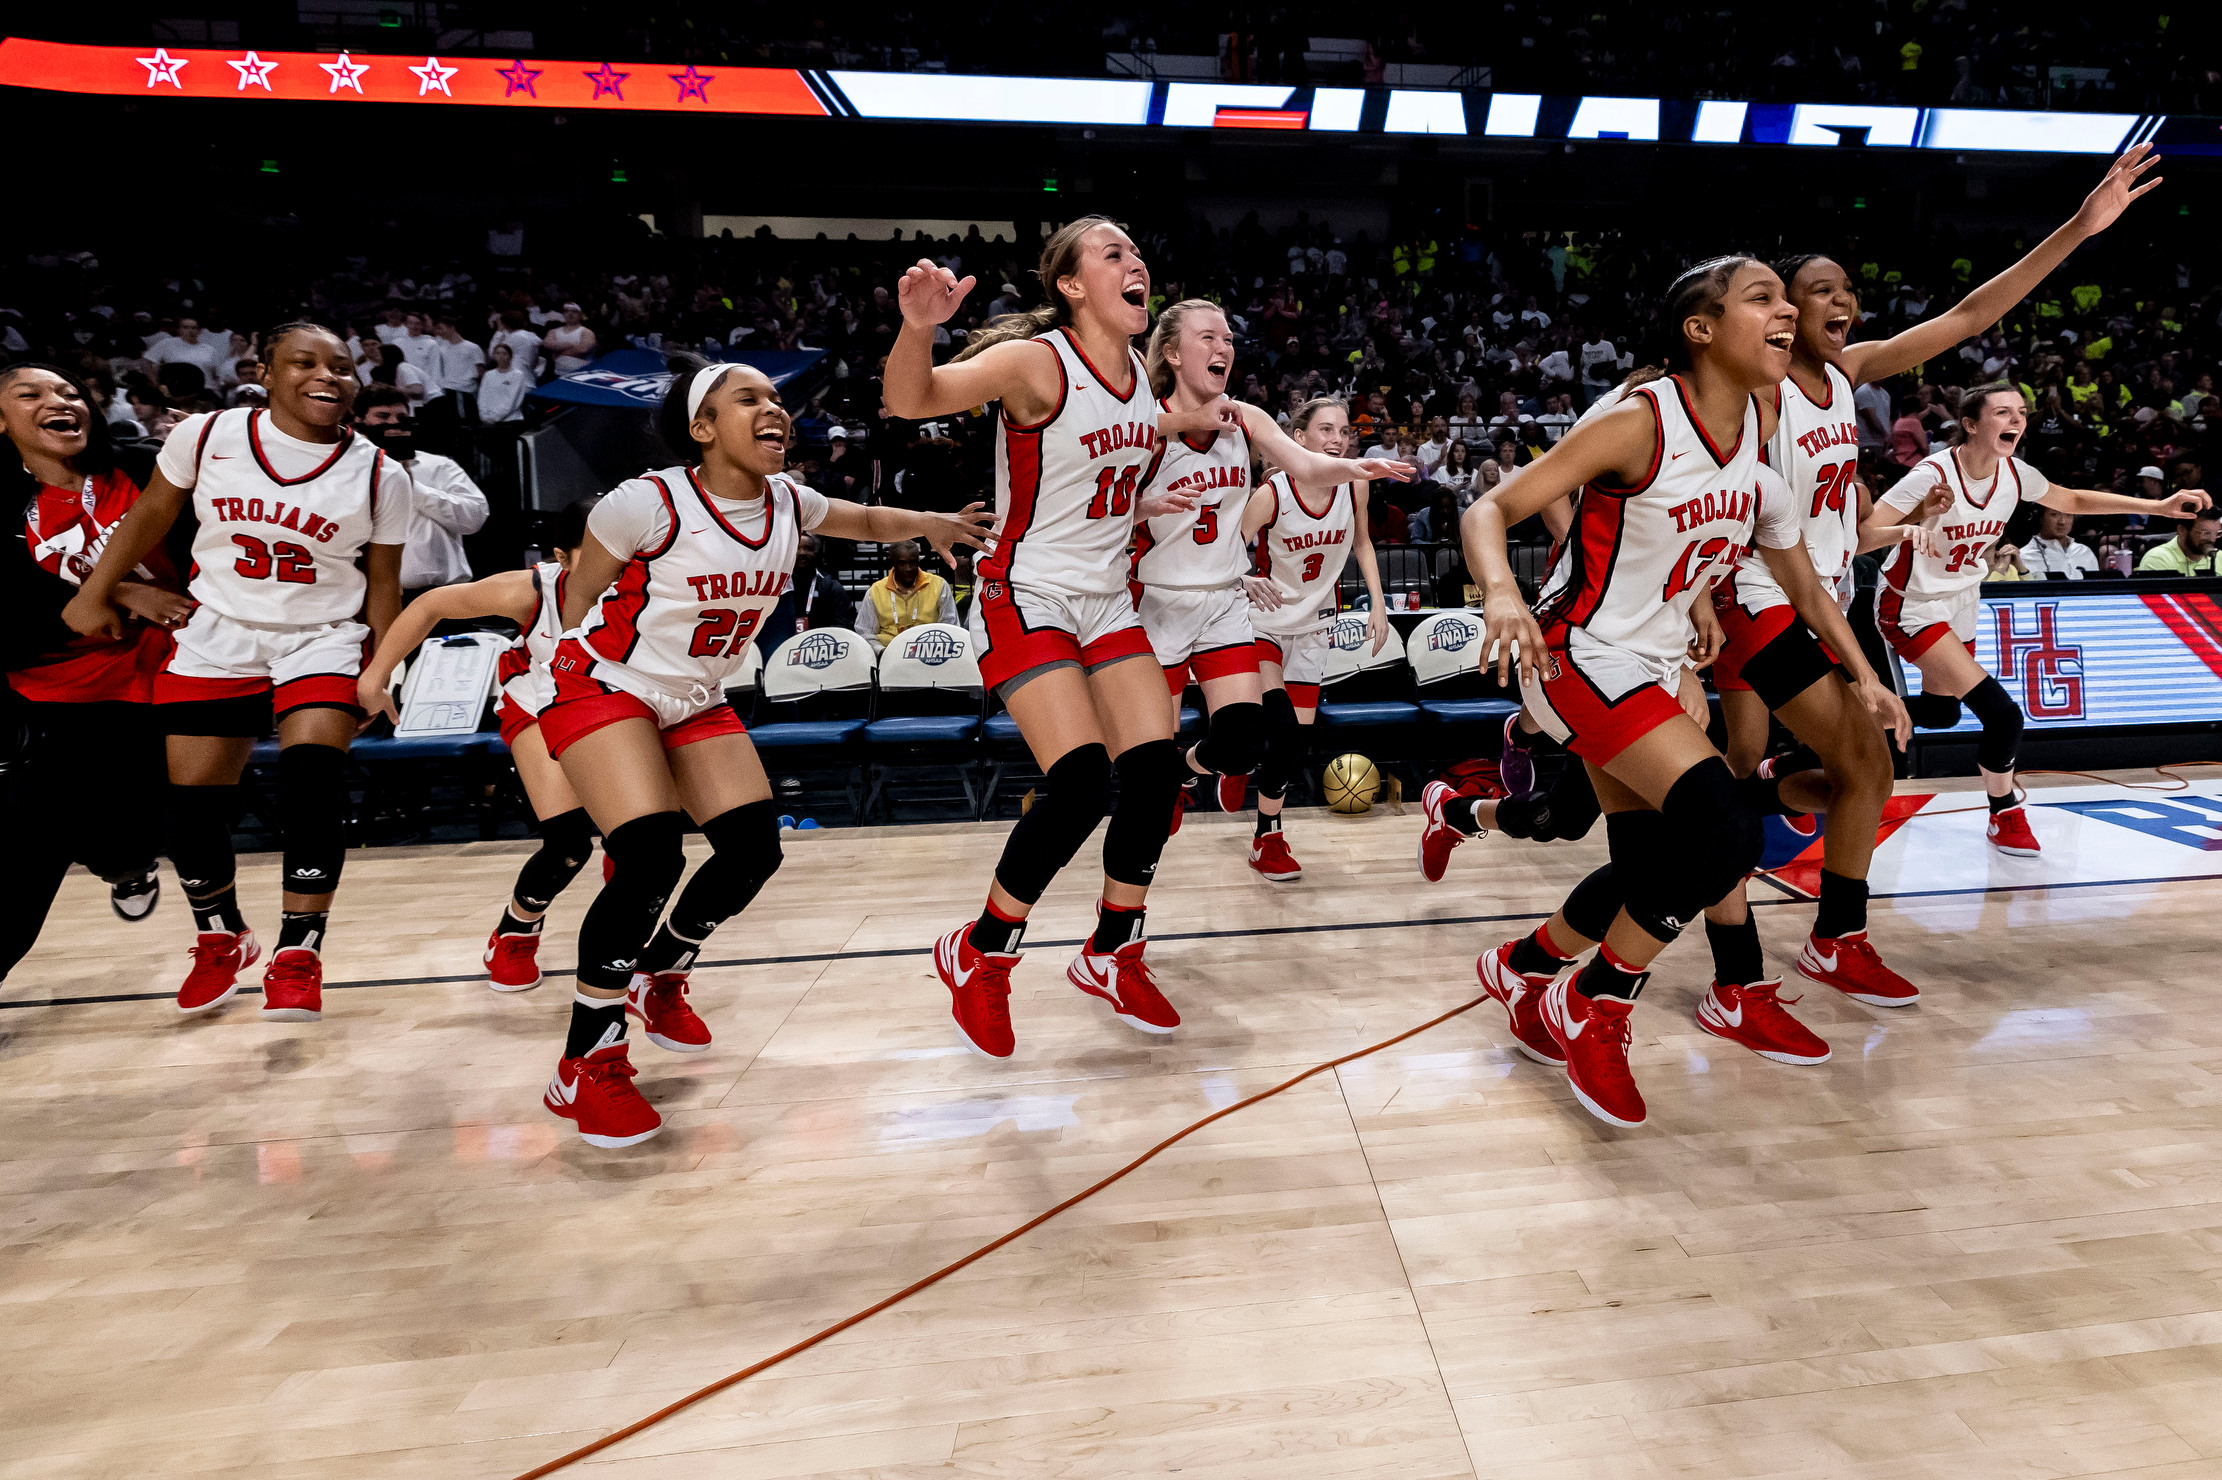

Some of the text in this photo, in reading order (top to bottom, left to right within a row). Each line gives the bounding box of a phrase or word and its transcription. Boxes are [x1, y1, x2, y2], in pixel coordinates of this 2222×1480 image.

[1079, 422, 1157, 459] TROJAN
[84, 477, 94, 506] AHSA
[1086, 464, 1141, 519] 10
[212, 497, 339, 543] TROJANS
[1193, 498, 1223, 545] 5
[1667, 490, 1752, 533] TROJAN
[231, 533, 316, 585] 32
[1302, 553, 1325, 583] 3
[686, 570, 790, 601] TROJAN
[688, 607, 764, 659] 22
[904, 642, 965, 658] FINALS
[1328, 625, 1368, 648] INAL
[1428, 625, 1477, 651] FINALS
[788, 642, 849, 665] FINALS
